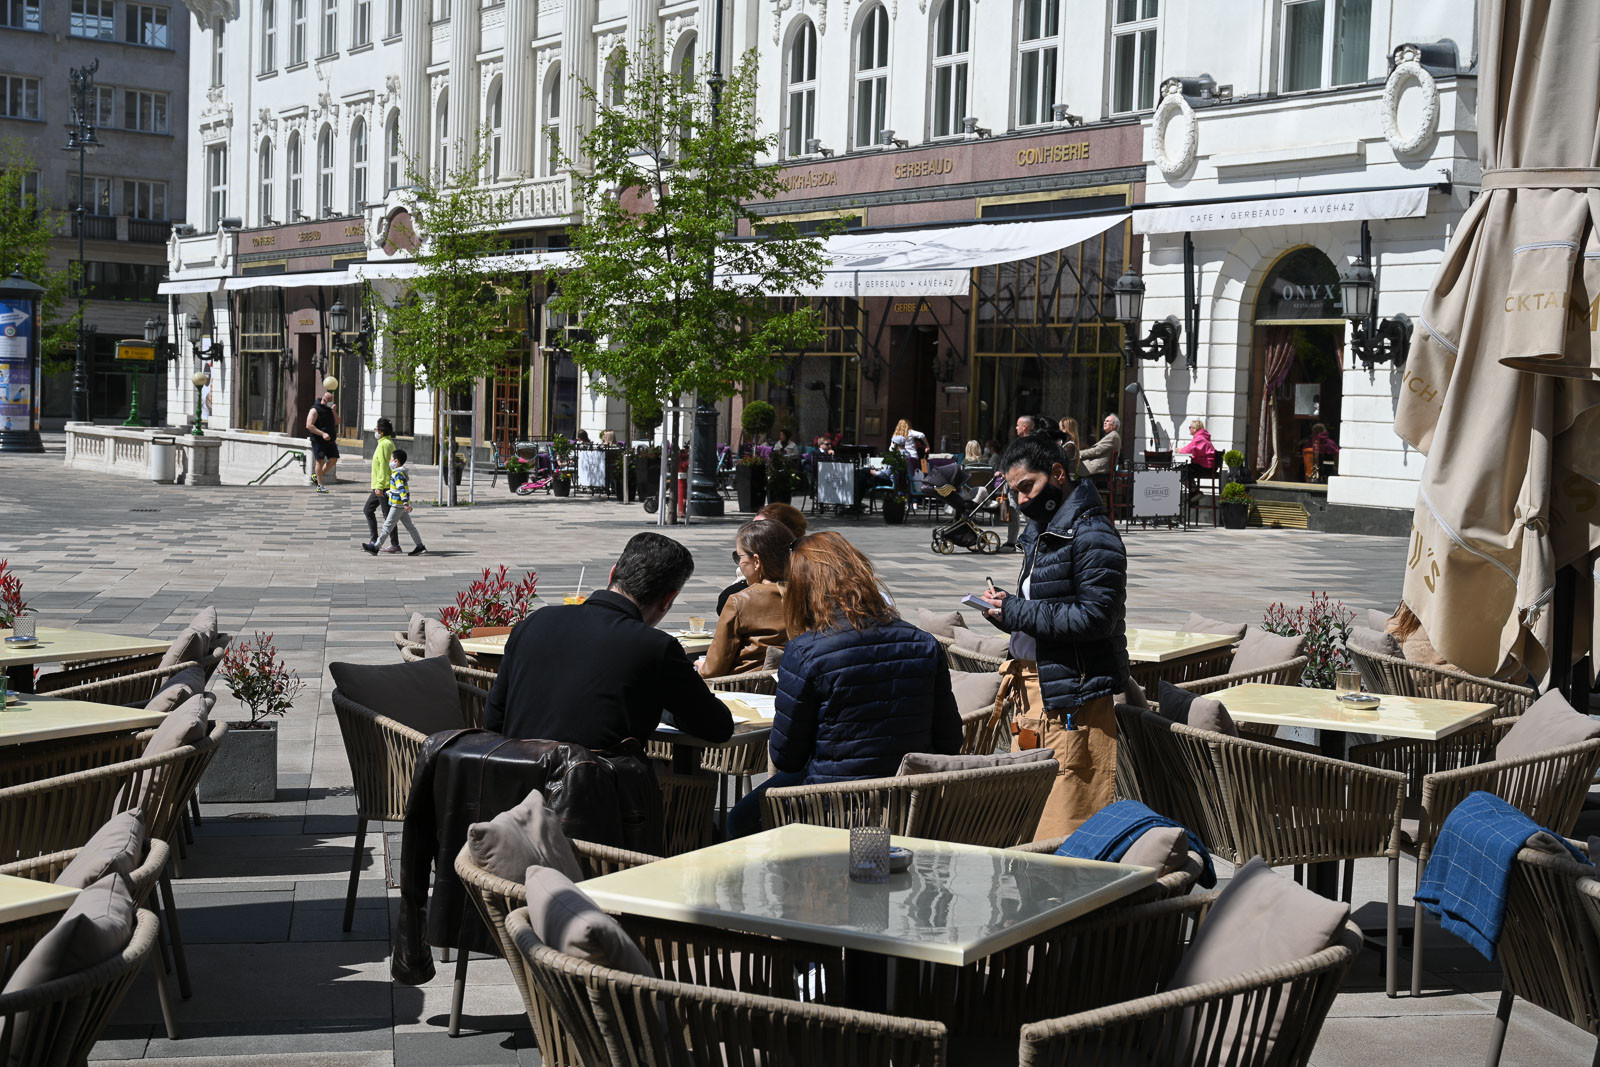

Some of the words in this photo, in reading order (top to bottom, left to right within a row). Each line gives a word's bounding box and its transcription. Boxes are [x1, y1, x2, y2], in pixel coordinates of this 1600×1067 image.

[893, 158, 953, 179] GERBEAUD
[1017, 141, 1091, 167] CONFISERIE
[1230, 208, 1286, 220] GERBEAUD
[865, 280, 906, 288] GERBEAUD
[1282, 284, 1336, 301] ONYX
